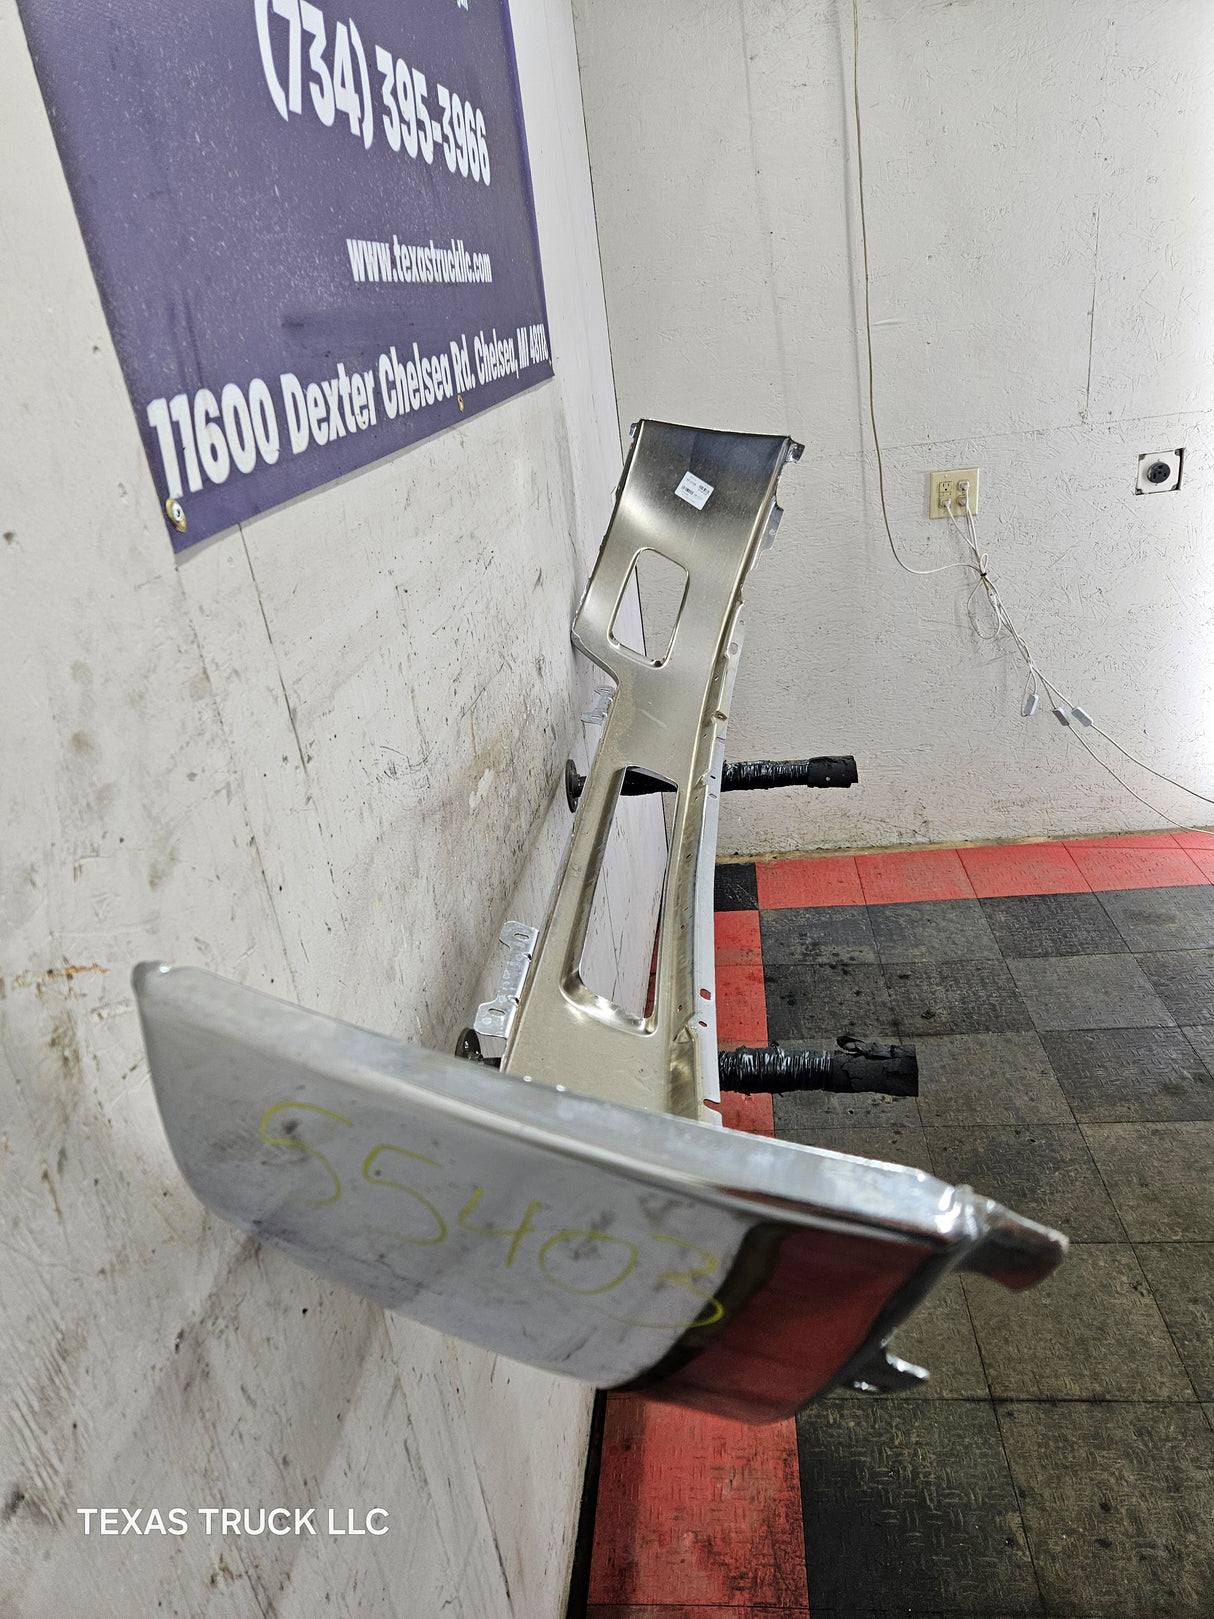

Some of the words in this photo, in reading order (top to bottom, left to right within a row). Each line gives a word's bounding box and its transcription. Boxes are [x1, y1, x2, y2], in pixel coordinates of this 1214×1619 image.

[254, 0, 374, 150] (734)
[375, 44, 491, 187] 395-3966
[346, 234, 493, 283] www.texastruckllc.com
[146, 377, 280, 500] 11600
[280, 362, 377, 455] Dexter
[378, 341, 454, 419] Chelsea
[450, 333, 476, 393] Rd.
[473, 328, 519, 385] Chelsea,
[516, 327, 530, 370] MI
